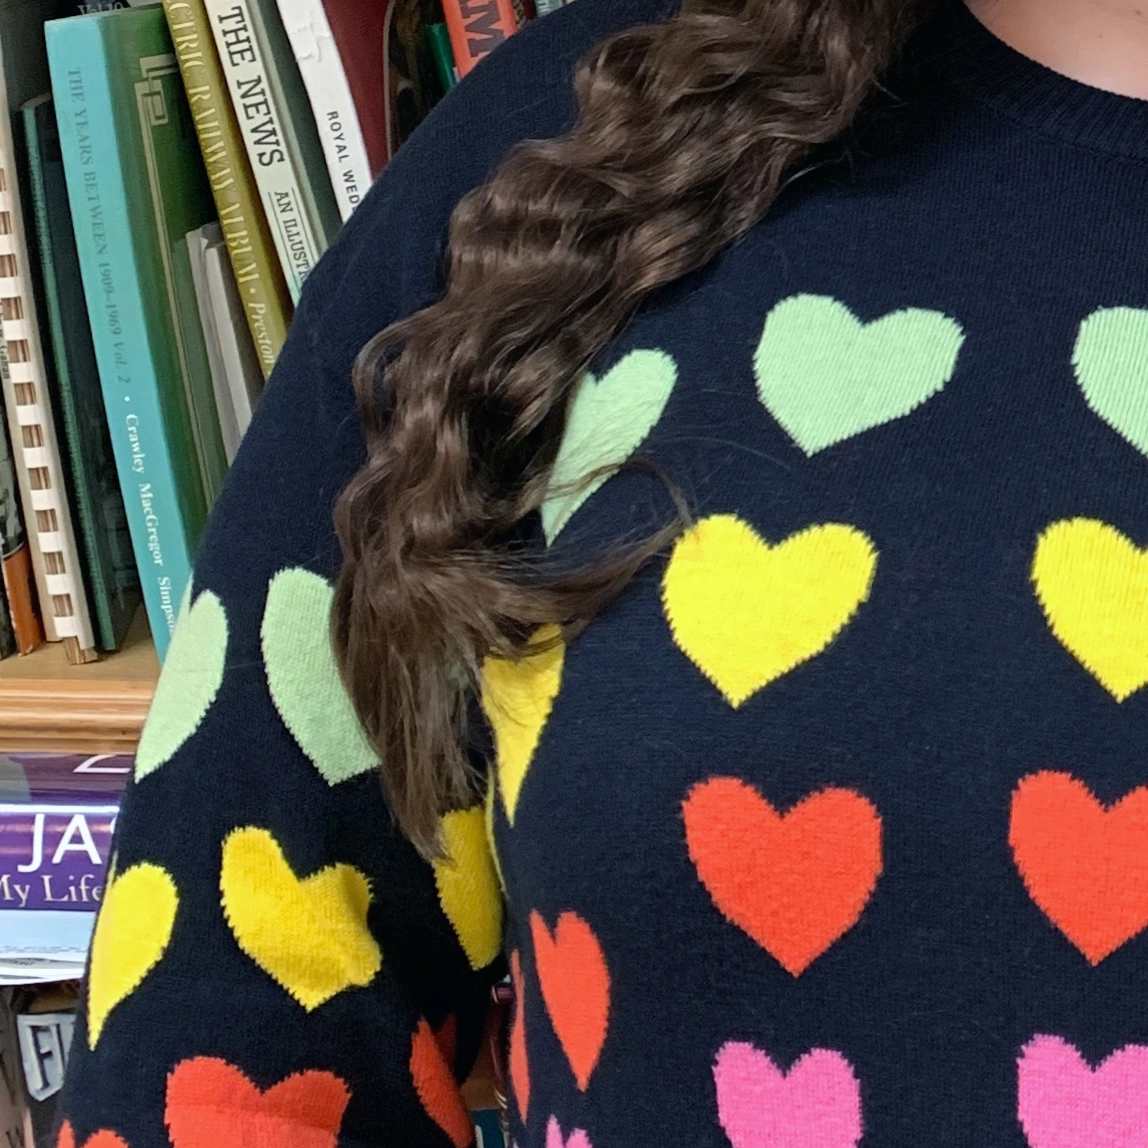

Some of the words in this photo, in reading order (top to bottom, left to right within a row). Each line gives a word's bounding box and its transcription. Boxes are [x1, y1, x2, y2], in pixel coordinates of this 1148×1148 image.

[217, 5, 258, 68] THE
[67, 66, 86, 108] THE
[74, 109, 95, 167] YEARS
[189, 85, 236, 190] RAILWAY
[236, 74, 286, 167] NEWS
[326, 110, 350, 164] ROYAL
[83, 170, 108, 254] BETWEEN
[274, 191, 294, 214] AN
[248, 301, 276, 364] Preston
[118, 374, 132, 385] 2
[125, 414, 146, 475] Crawley
[138, 482, 165, 567] MacGregor
[41, 874, 103, 902] Life
